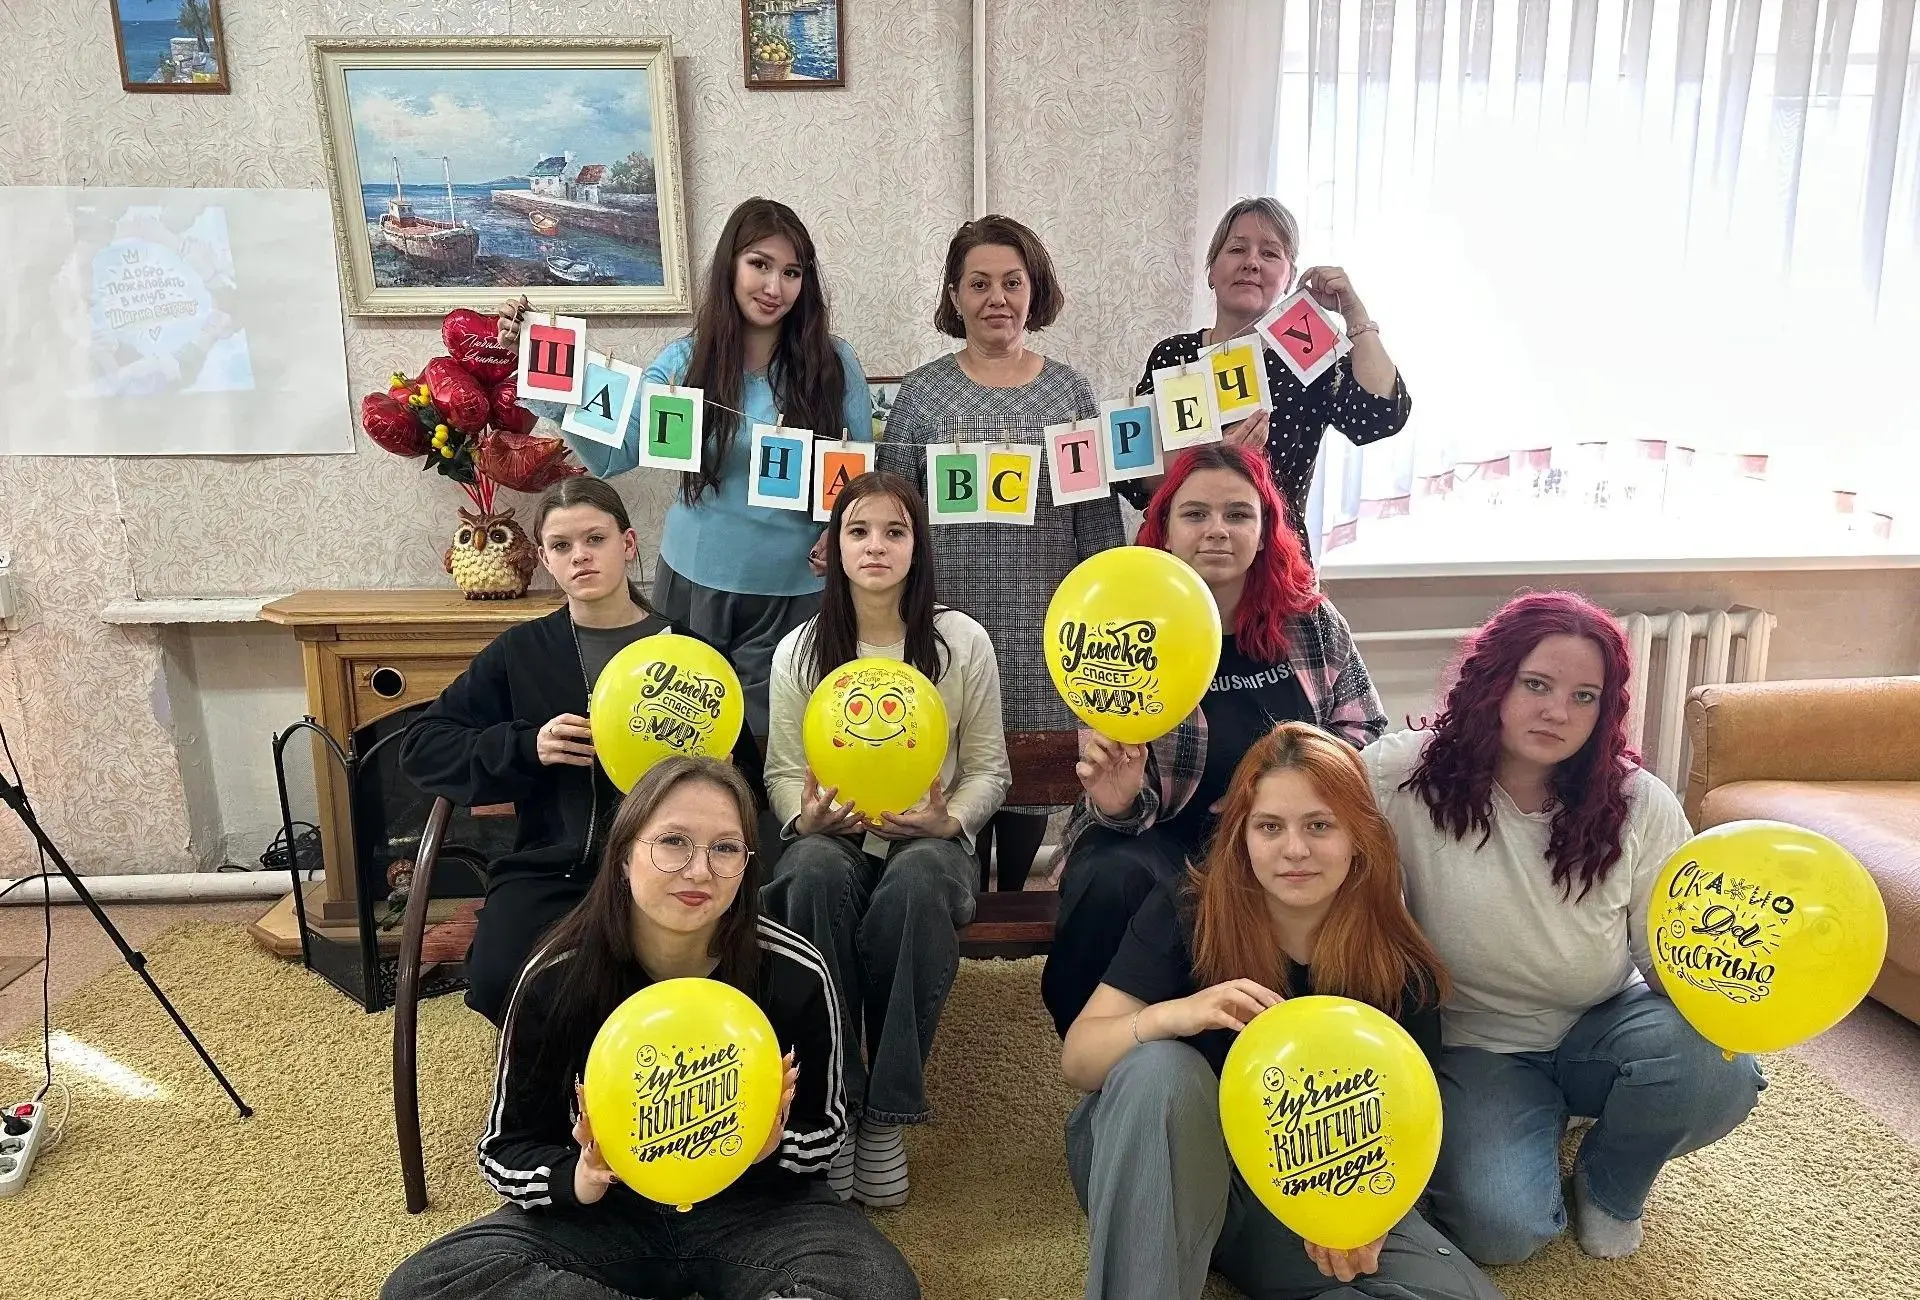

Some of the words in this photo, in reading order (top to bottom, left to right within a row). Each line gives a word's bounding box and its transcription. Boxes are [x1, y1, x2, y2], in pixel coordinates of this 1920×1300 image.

[1059, 620, 1158, 673] Улыбка
[640, 661, 726, 719] Улыбка
[1083, 667, 1130, 684] СПАСЕТ
[662, 696, 700, 720] СПАСЕТ
[1081, 689, 1145, 714] МИР!
[645, 715, 701, 749] МИР!
[638, 1067, 739, 1141] КОНЕЧНО
[1272, 1096, 1381, 1173] КОНЕЧНО
